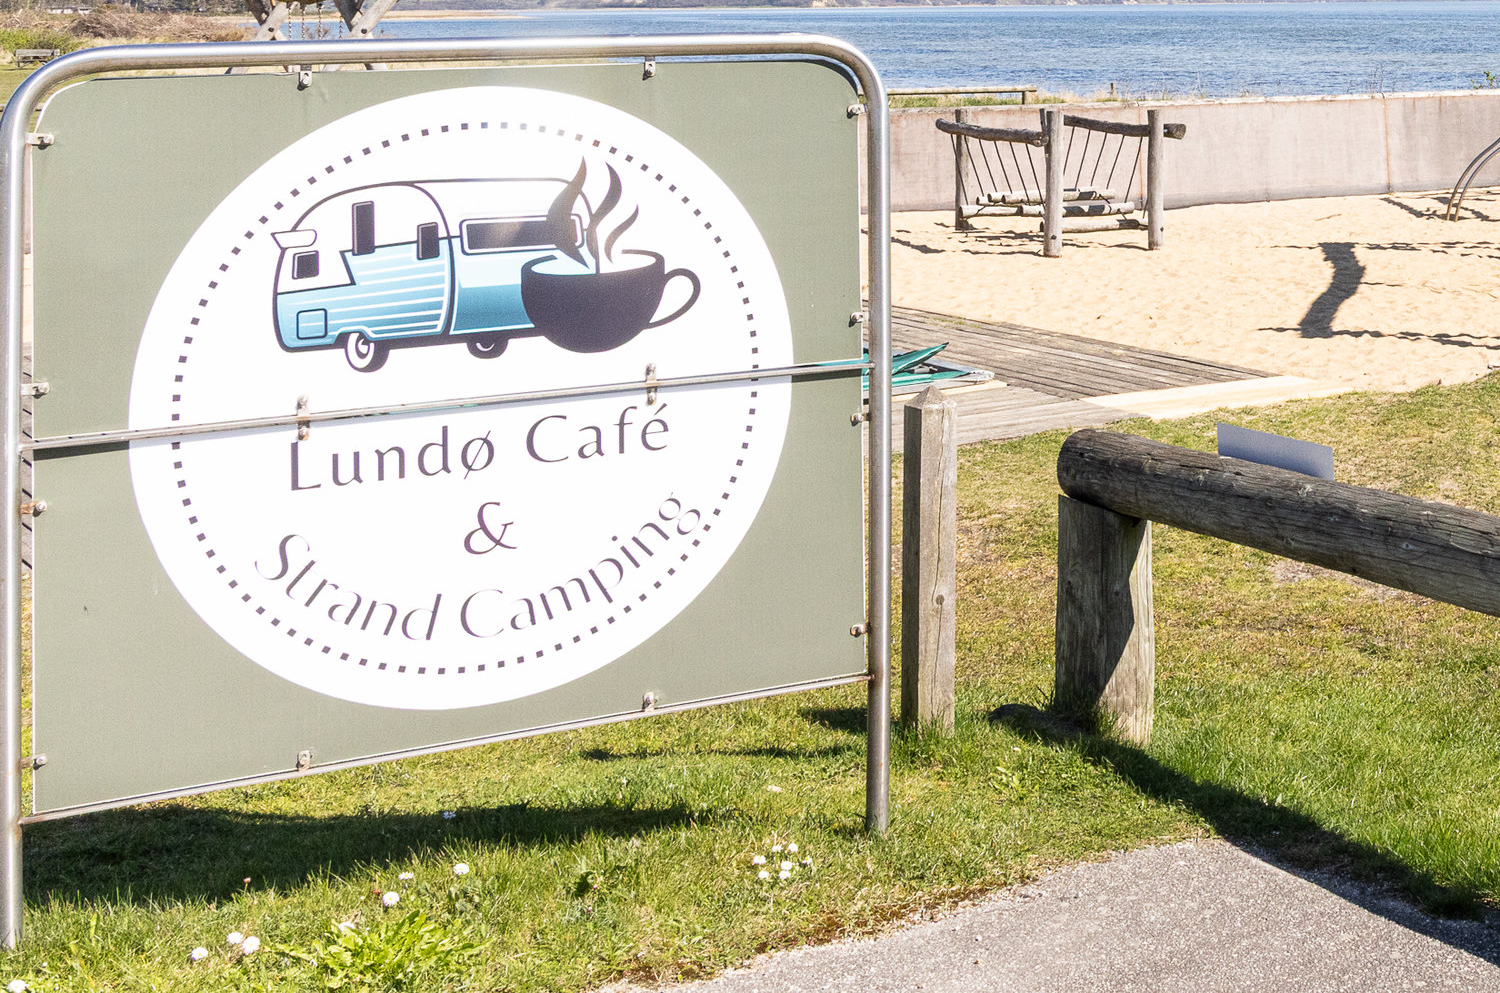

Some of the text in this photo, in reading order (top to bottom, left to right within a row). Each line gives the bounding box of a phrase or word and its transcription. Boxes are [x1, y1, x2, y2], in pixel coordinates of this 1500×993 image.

[290, 402, 669, 491] Lundø Café
[254, 492, 701, 641] Strand Camping
[463, 501, 518, 555] &
